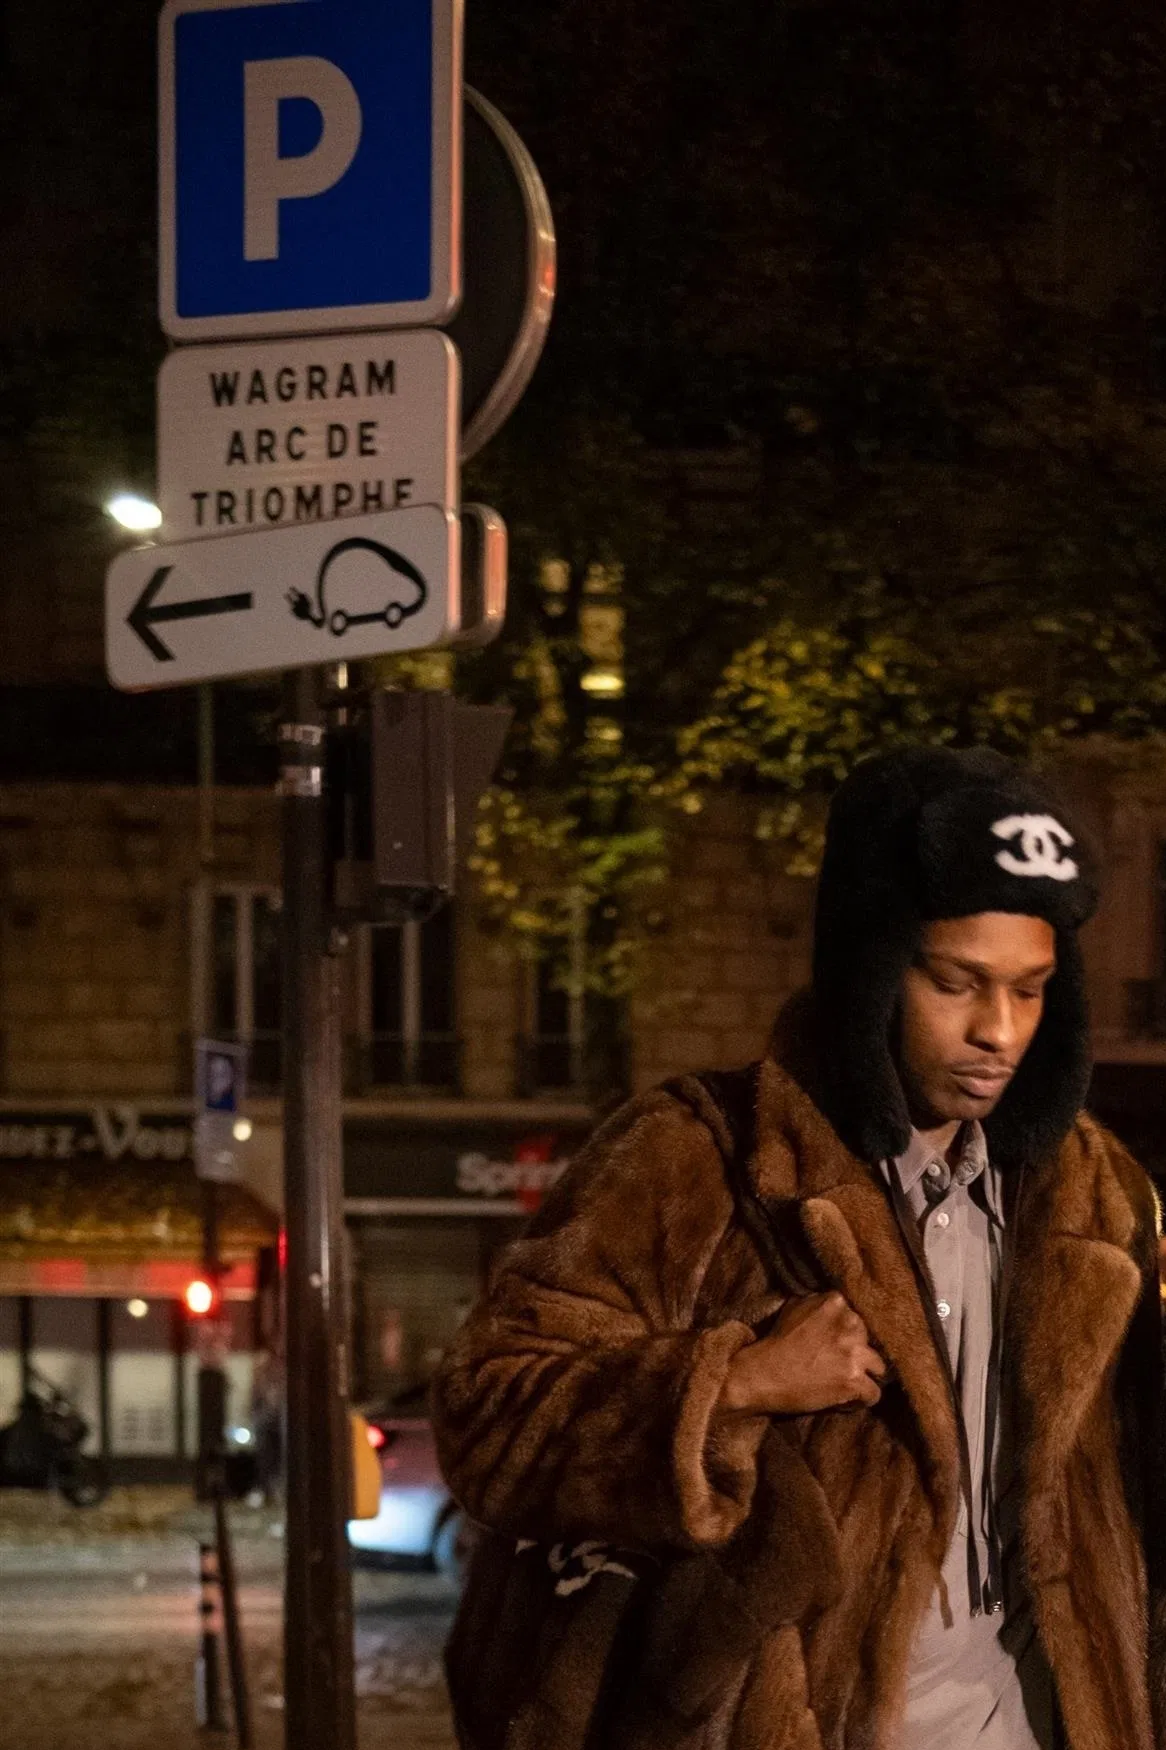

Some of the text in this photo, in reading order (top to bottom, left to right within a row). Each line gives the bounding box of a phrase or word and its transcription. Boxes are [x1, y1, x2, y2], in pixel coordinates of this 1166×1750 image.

[243, 55, 362, 261] P
[209, 359, 396, 407] WAGRAM
[226, 421, 378, 466] ARC DE
